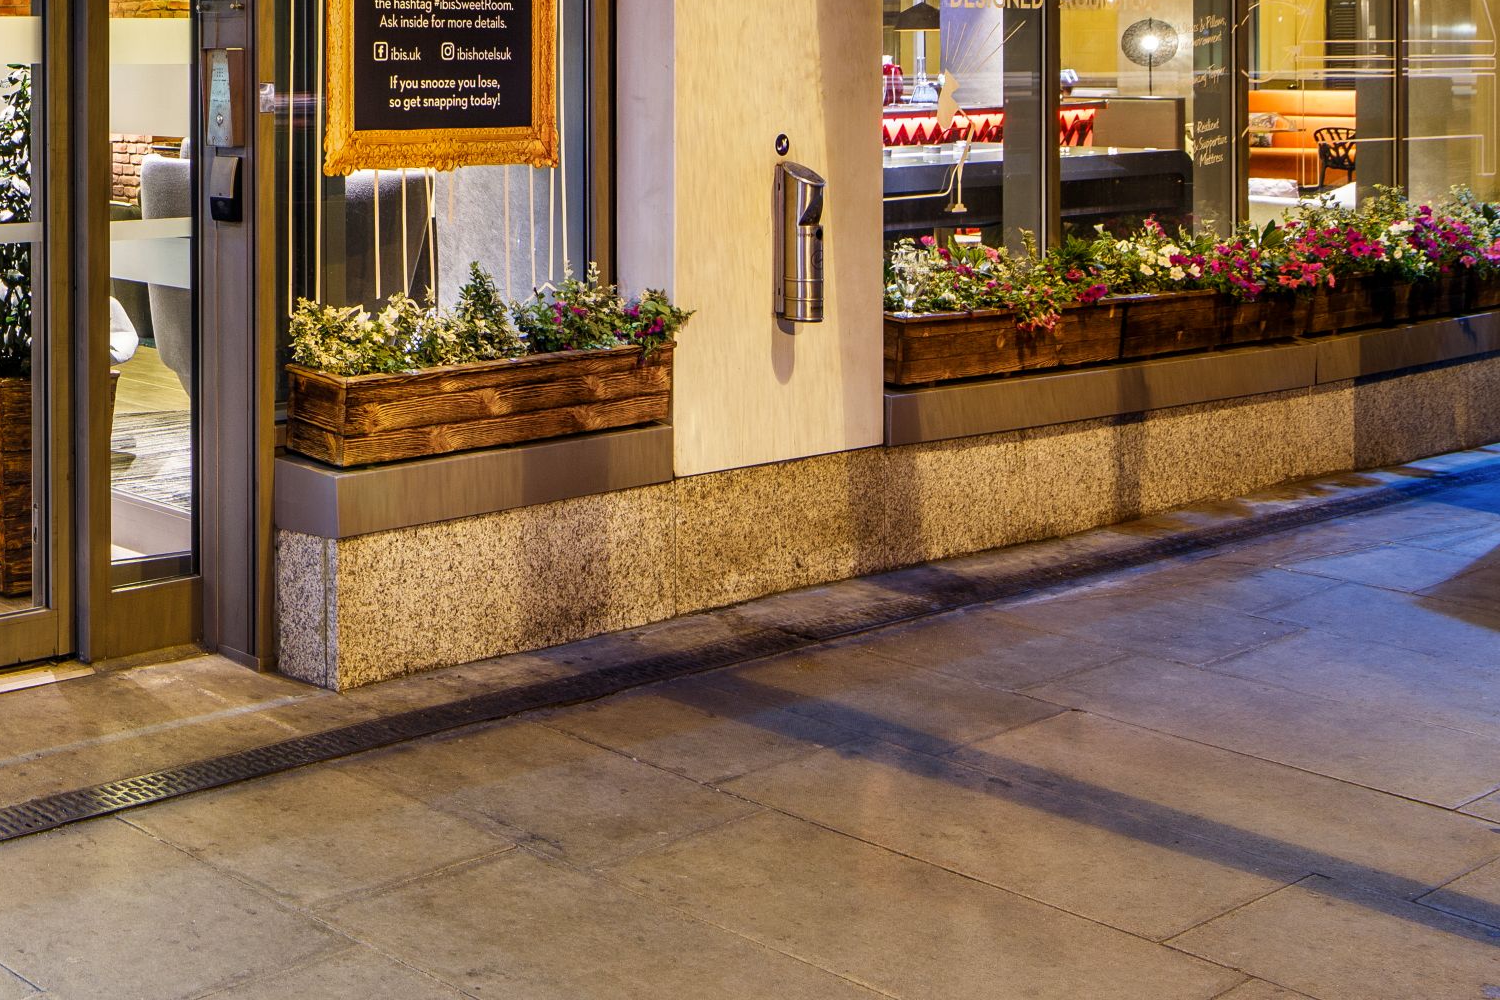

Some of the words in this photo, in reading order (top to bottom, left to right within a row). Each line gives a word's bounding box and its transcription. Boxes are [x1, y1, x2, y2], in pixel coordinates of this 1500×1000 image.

[380, 14, 398, 27] Ask
[401, 14, 428, 28] inside
[431, 14, 445, 28] for
[448, 20, 472, 28] more
[475, 15, 506, 28] details.
[391, 47, 421, 60] ibis.uk
[457, 47, 511, 60] ibishotelsuk
[390, 75, 398, 88] If
[400, 80, 418, 92] you
[421, 80, 456, 88] snooze
[458, 80, 476, 91] you
[478, 75, 500, 89] lose,
[390, 99, 401, 107] so
[404, 96, 421, 110] get
[423, 94, 468, 110] snapping
[470, 92, 500, 109] today!
